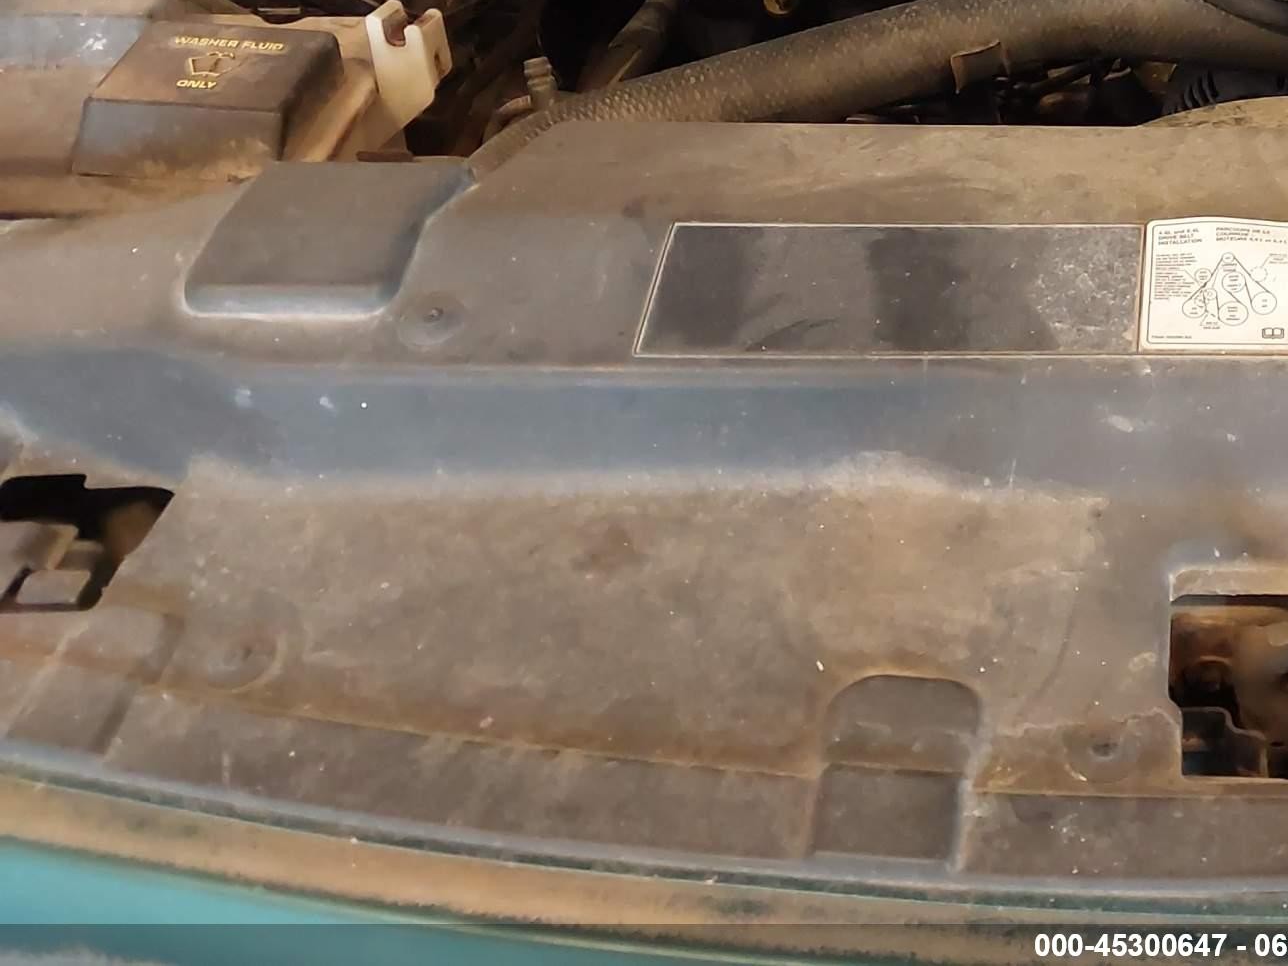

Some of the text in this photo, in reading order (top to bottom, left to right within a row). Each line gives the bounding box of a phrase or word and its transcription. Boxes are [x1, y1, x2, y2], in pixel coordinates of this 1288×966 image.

[175, 36, 284, 51] WASHER FLUID
[176, 79, 217, 89] ONLY
